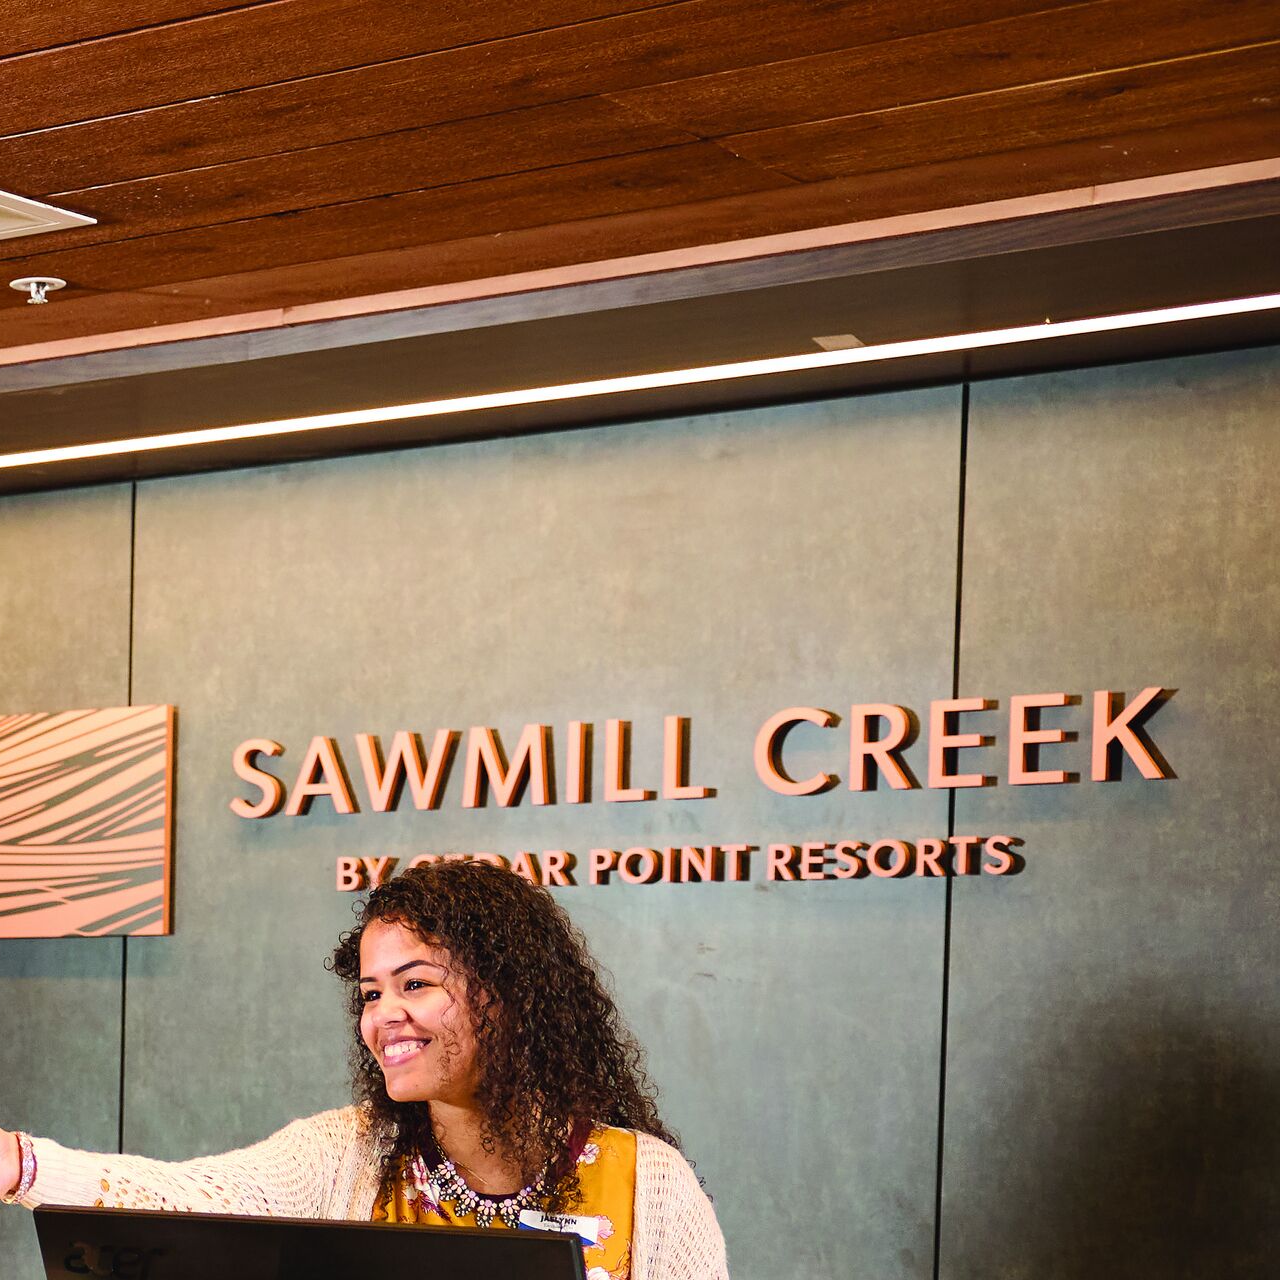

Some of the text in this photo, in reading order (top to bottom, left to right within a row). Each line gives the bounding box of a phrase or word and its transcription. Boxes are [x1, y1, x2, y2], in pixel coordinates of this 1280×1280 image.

[229, 686, 1170, 819] SAWMILL CREEK
[335, 855, 391, 892] BY
[589, 843, 751, 886] POINT
[766, 835, 1019, 881] RESORTS
